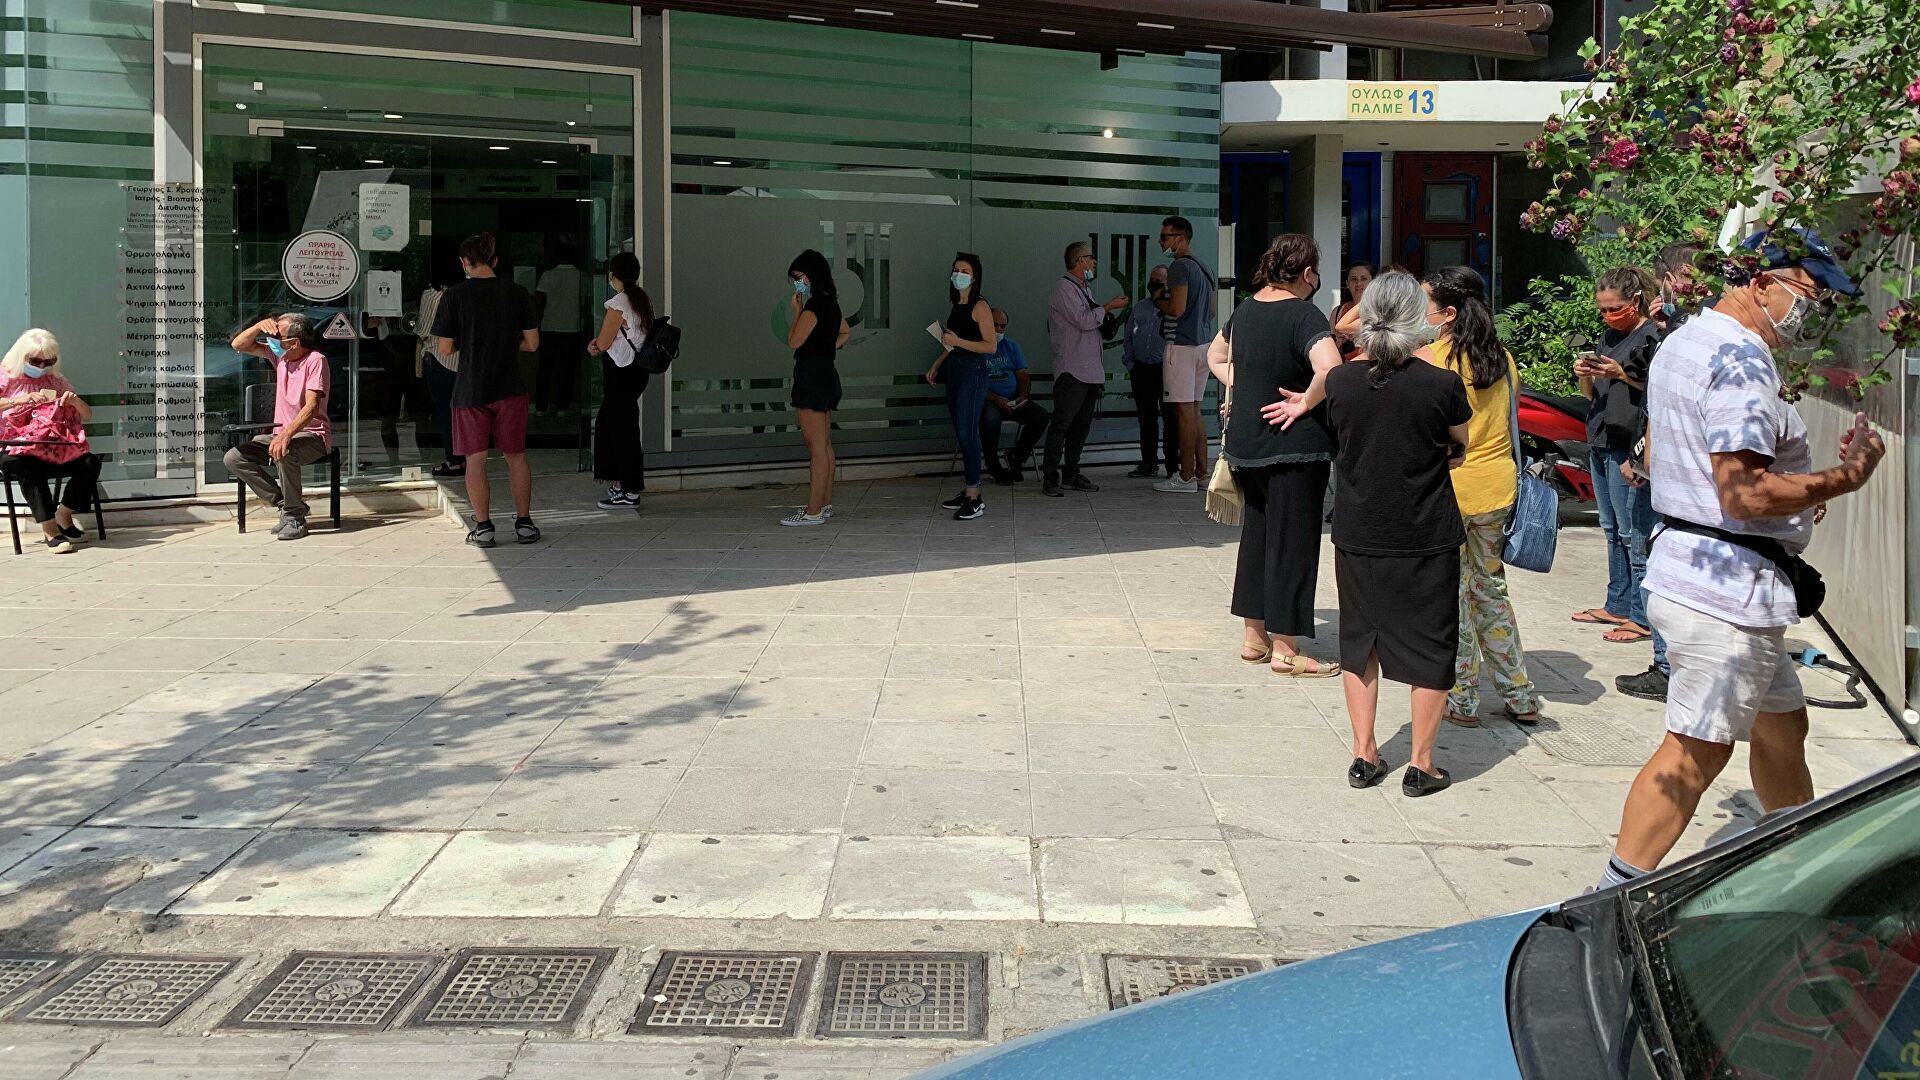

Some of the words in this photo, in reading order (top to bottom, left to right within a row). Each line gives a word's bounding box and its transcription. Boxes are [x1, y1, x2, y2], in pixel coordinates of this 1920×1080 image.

[1351, 88, 1404, 99] ΟΥΛΩΦ
[1408, 89, 1435, 115] 13
[1351, 103, 1403, 114] ΠΑΛΜΕ
[127, 185, 165, 194] Γεώργιος
[135, 195, 160, 203] Ιατρός
[167, 195, 222, 204] Βιοπαθολόγος
[158, 204, 200, 212] Διευθυντής
[308, 241, 336, 249] ΩΡΑΡΙΟ
[125, 250, 192, 259] Ορμονολογικό
[298, 249, 345, 257] ΛΕΙΤΟΥΡΓΙΑΣ
[125, 266, 196, 275] Μικροβιολογικό
[125, 283, 186, 292] Ακτινολογικό
[126, 299, 167, 308] Ψηφιακή
[126, 332, 168, 341] Μέτρηση
[169, 331, 204, 340] οστικής
[127, 349, 171, 359] Υπέρηχοι
[127, 365, 157, 373] Triplex
[160, 364, 196, 373] καρδιάς
[127, 381, 148, 389] Τεστ
[150, 381, 199, 389] κοπώσεως
[127, 398, 155, 406] Holter
[157, 396, 191, 406] Ρυθμού
[127, 412, 195, 422] Κυτταρολογικό
[127, 431, 168, 439] Αξονικός
[128, 447, 180, 455] Μαγνητικός
[182, 445, 227, 454] Τομογράφ
